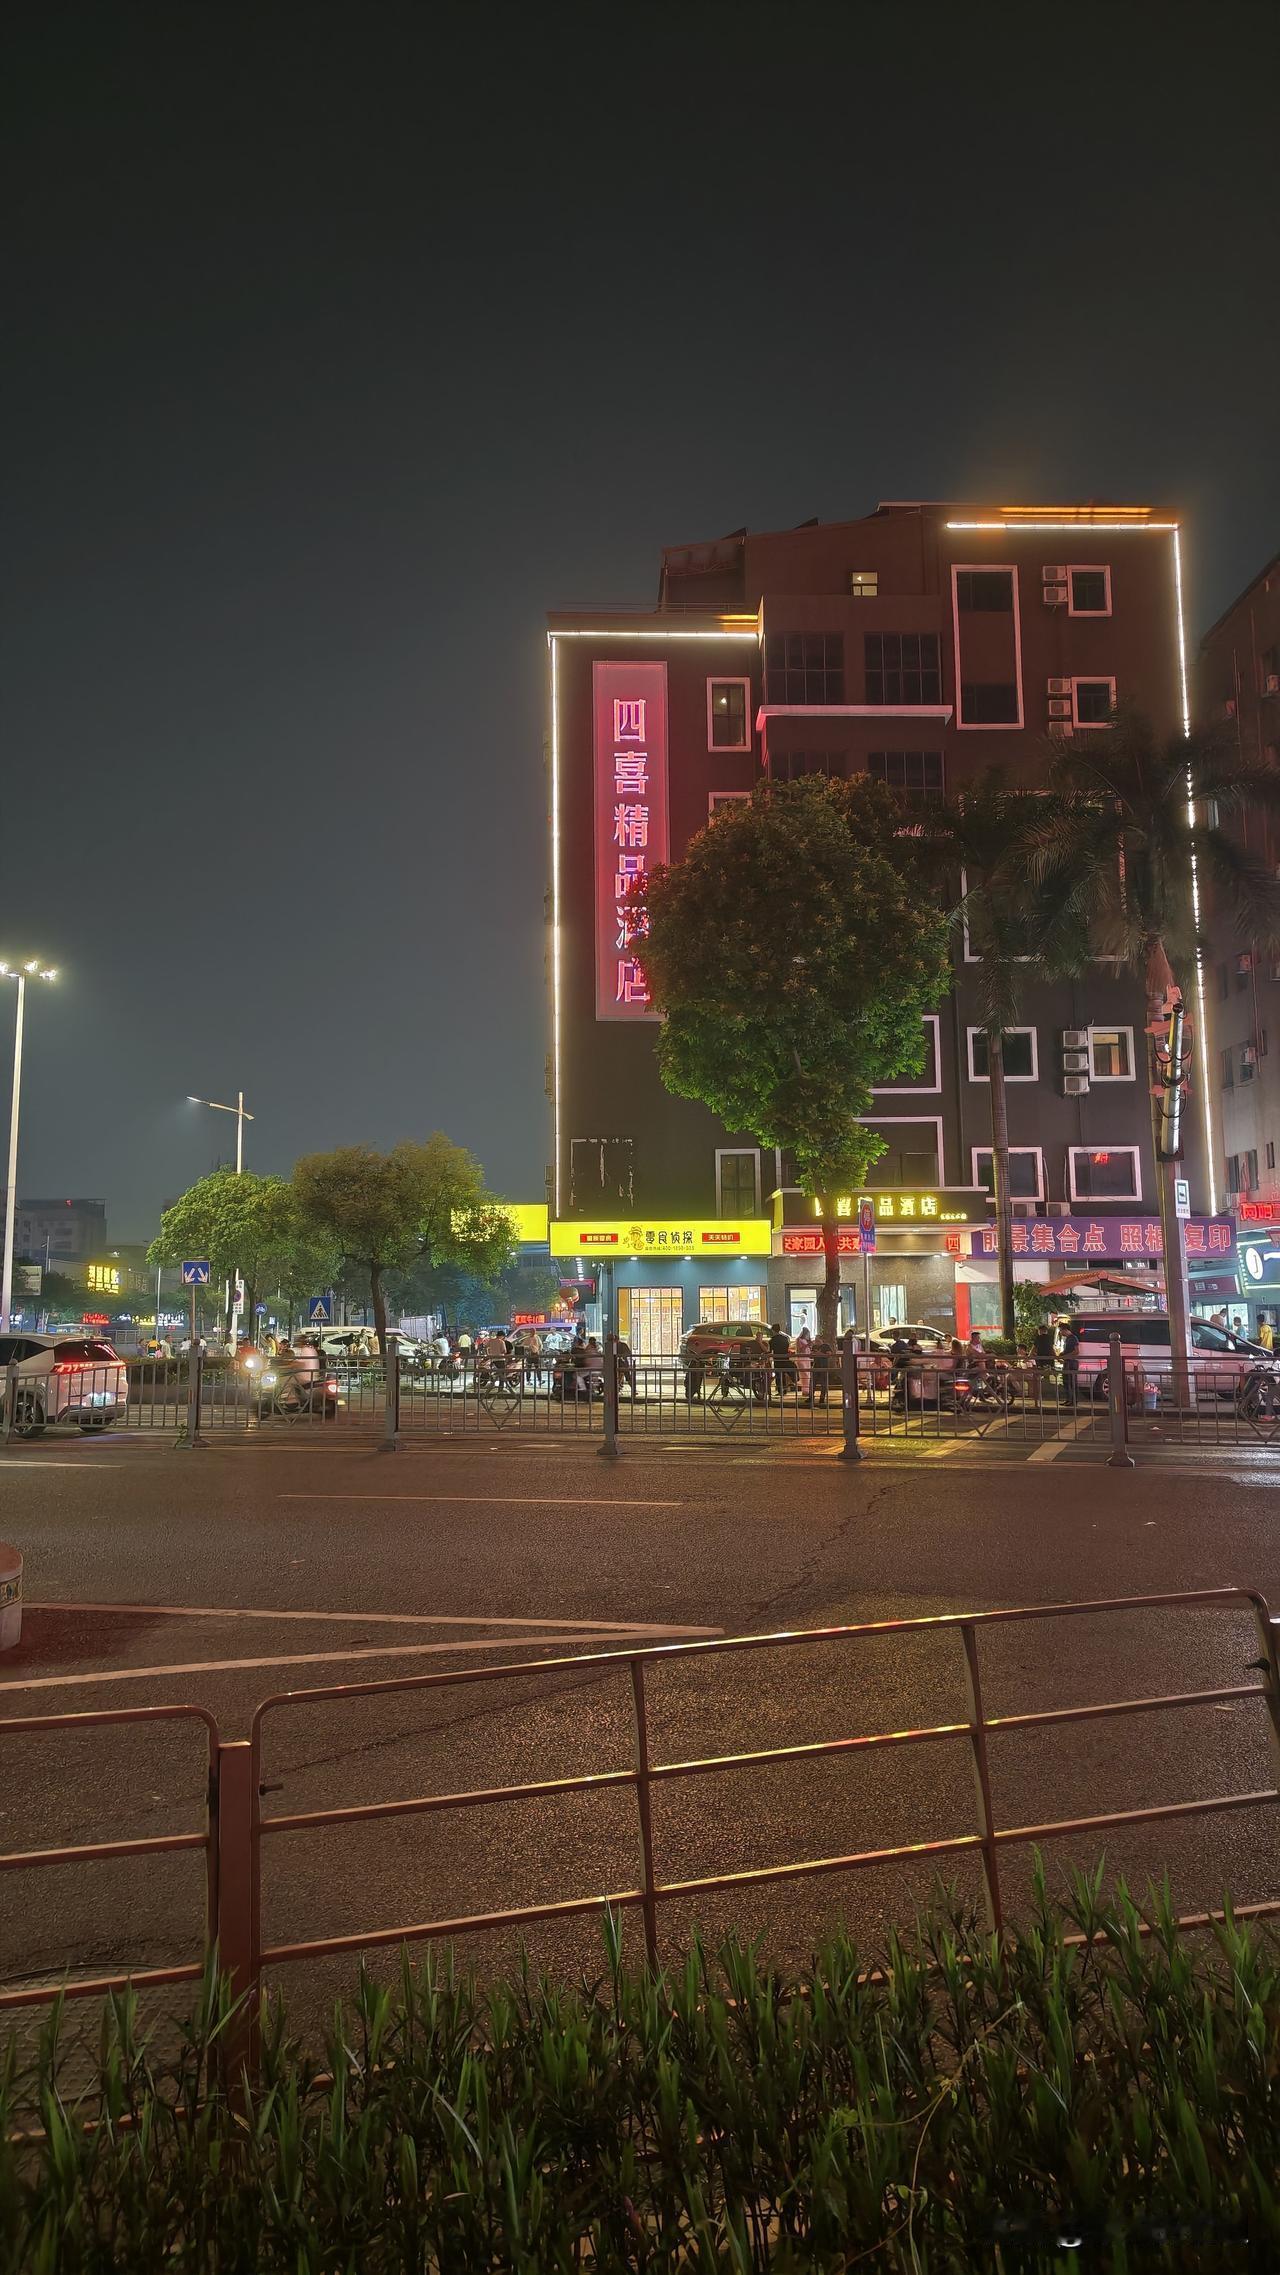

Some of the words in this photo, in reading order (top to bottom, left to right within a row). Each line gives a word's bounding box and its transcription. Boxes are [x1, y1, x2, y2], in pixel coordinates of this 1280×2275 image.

[814, 1196, 937, 1217] 喜品酒店
[1184, 1225, 1231, 1251] 复印
